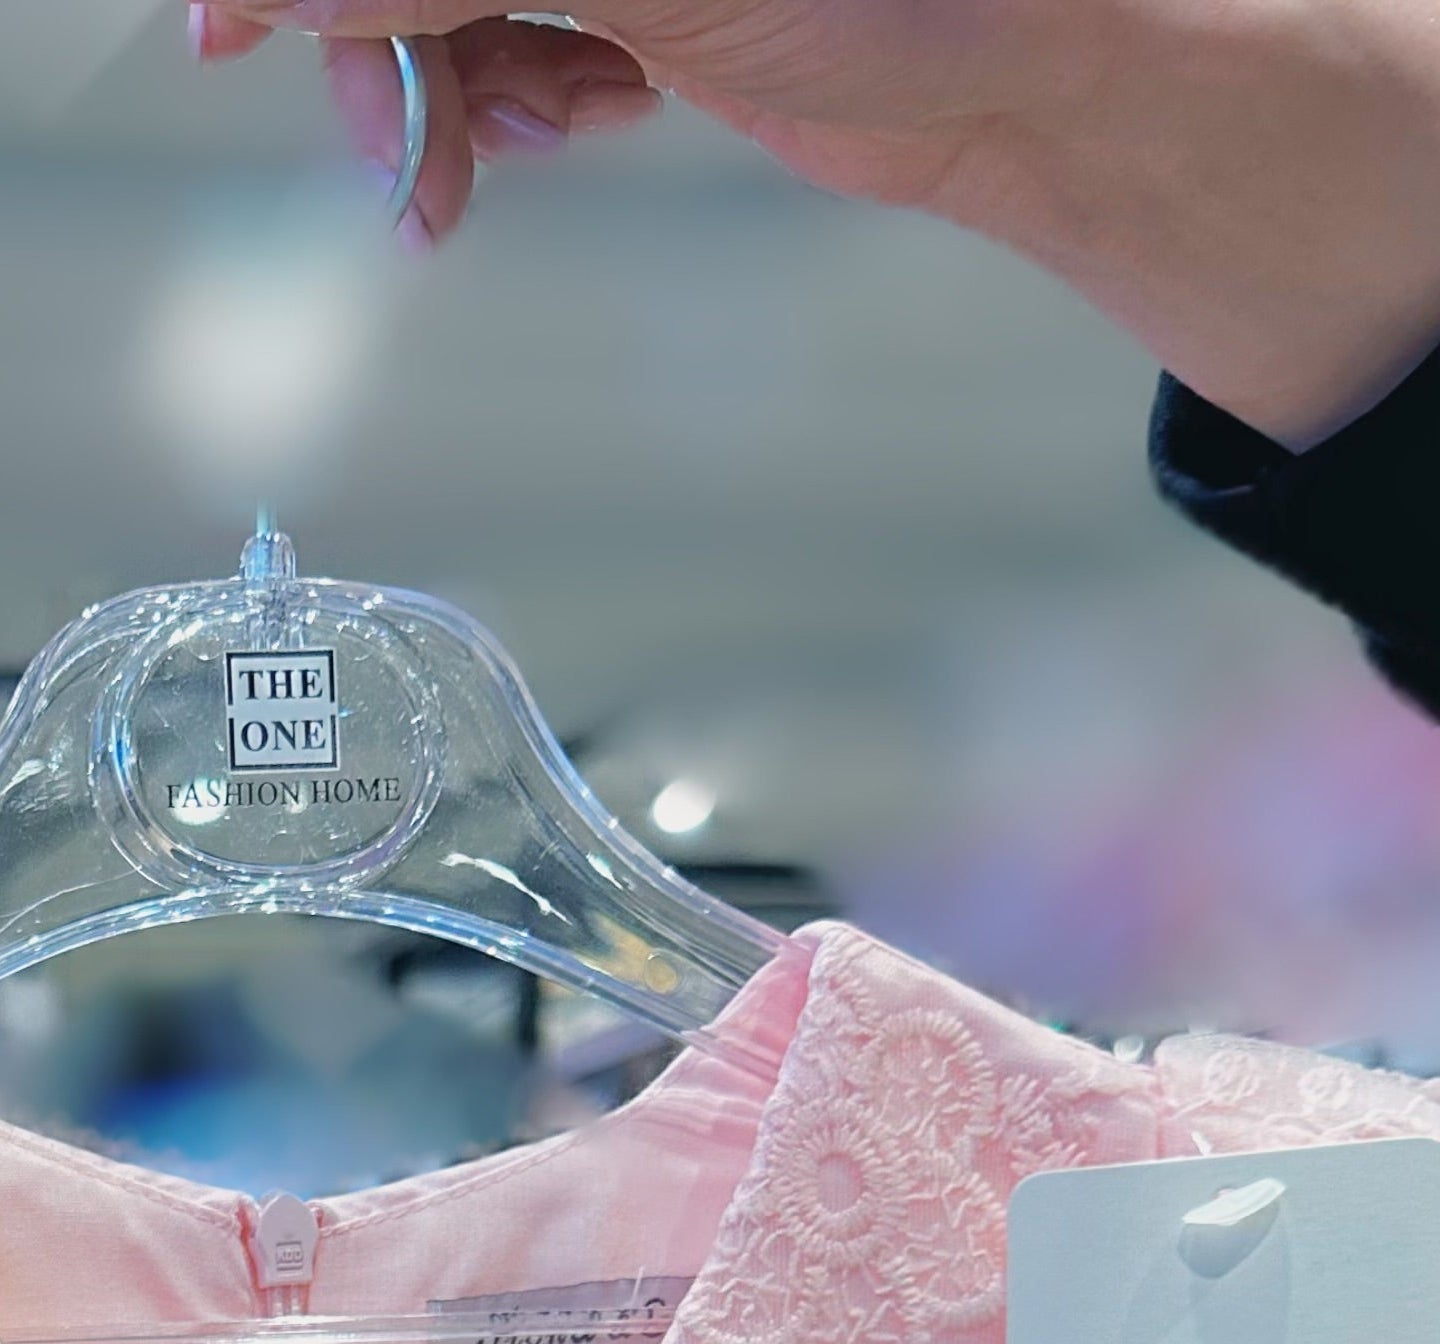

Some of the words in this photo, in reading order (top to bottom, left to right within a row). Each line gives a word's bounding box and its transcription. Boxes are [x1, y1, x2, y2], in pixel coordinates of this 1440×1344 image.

[238, 669, 323, 700] THE
[241, 719, 326, 752] ONE
[167, 780, 301, 809] FASHION
[312, 777, 401, 804] HOME
